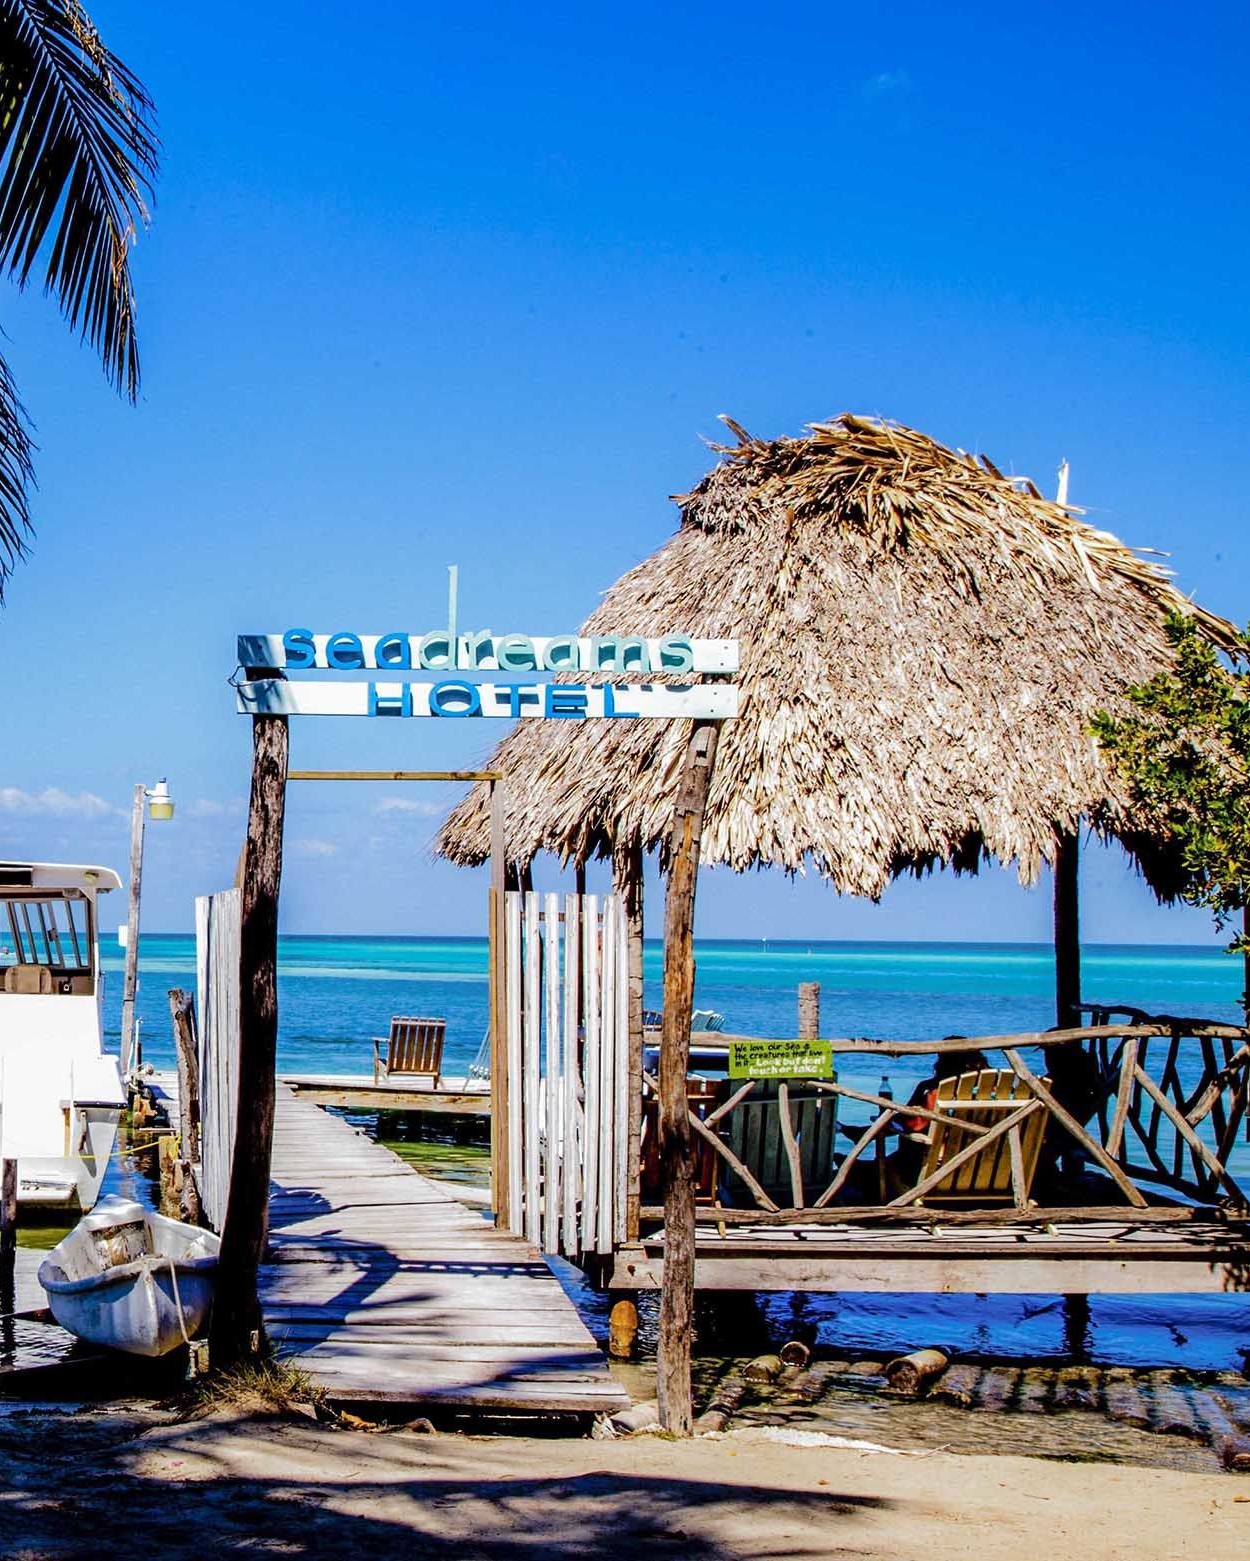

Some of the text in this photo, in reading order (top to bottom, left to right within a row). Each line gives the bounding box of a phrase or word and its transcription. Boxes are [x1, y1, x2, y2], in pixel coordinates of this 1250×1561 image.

[282, 565, 695, 674] seadreams
[367, 679, 641, 719] HOTEL
[734, 1043, 747, 1052] We
[767, 1042, 782, 1050] our
[734, 1051, 747, 1060] the
[750, 1051, 790, 1059] creatures
[792, 1049, 807, 1058] that
[756, 1057, 781, 1066] Look
[783, 1057, 800, 1066] but
[749, 1066, 777, 1075] touch
